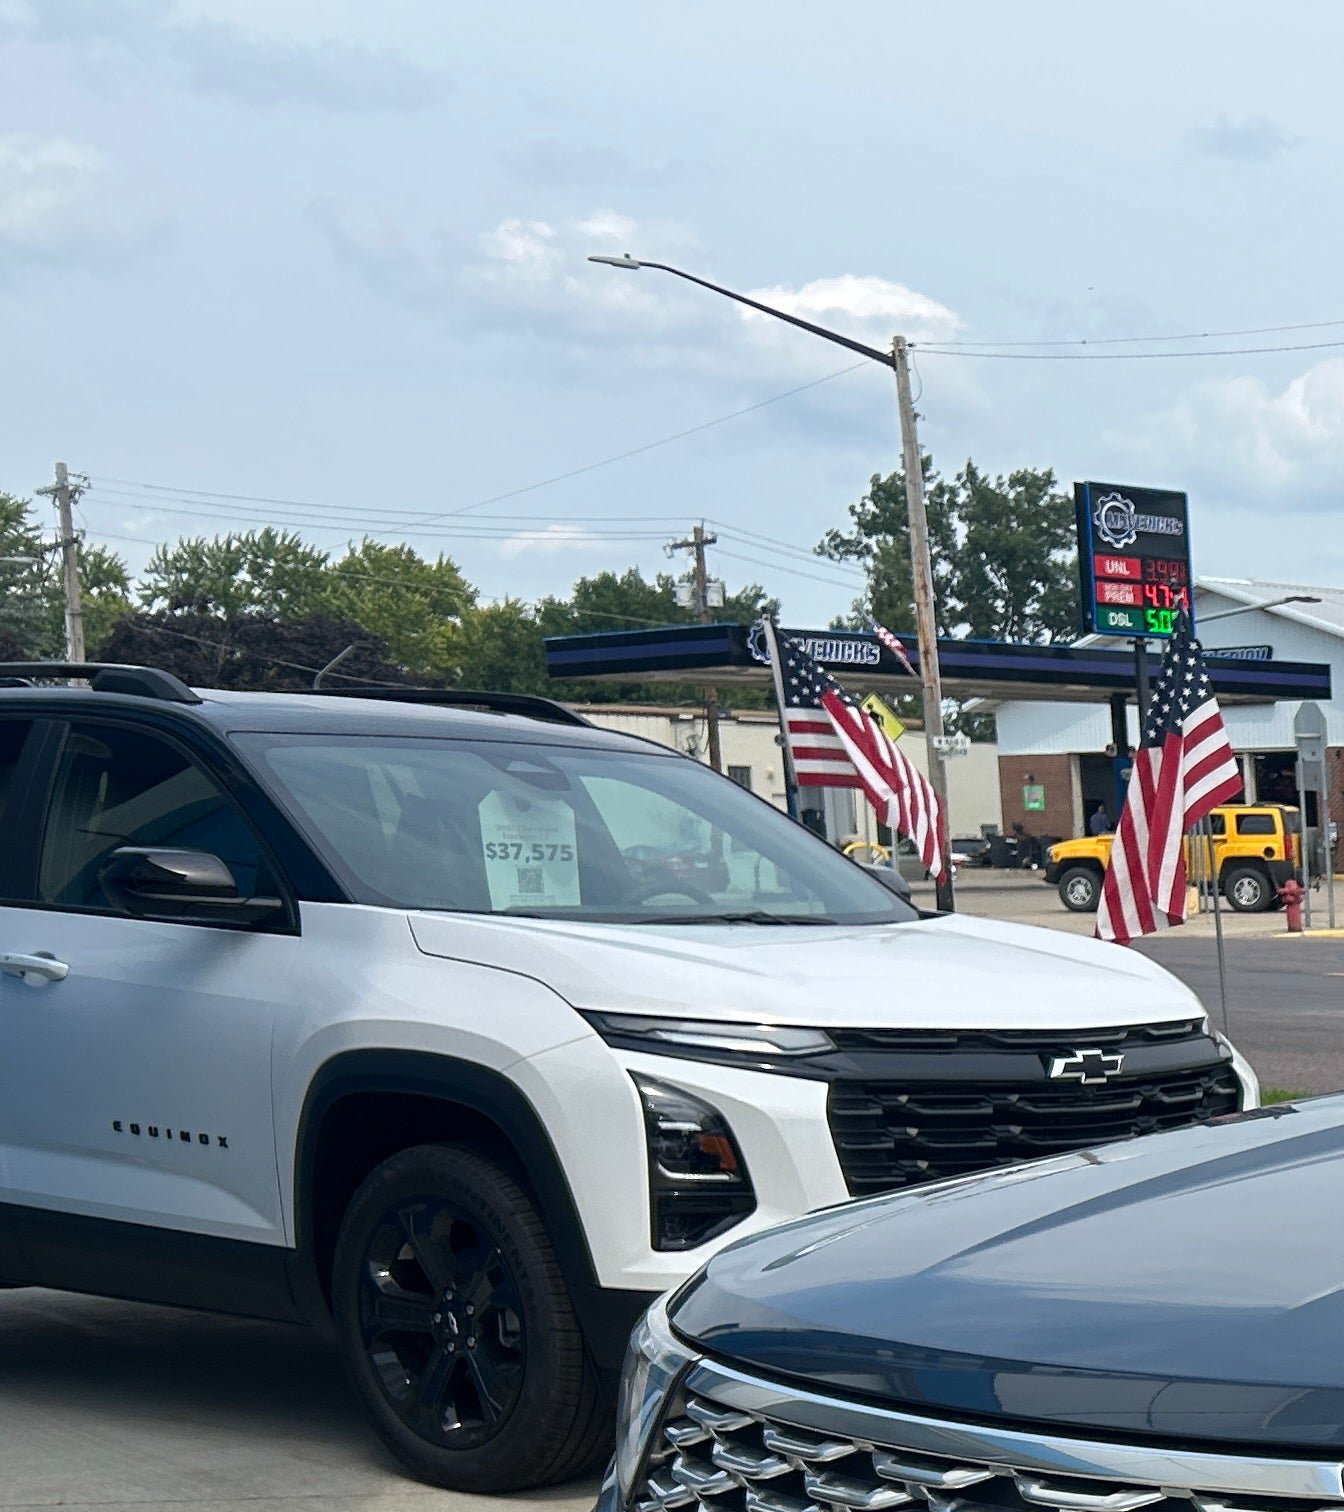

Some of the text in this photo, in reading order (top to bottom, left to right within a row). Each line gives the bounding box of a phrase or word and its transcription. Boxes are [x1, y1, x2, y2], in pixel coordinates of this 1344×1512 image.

[1104, 560, 1130, 575] UNL
[1108, 612, 1133, 627] DSL
[485, 842, 573, 864] $37,575
[112, 1120, 228, 1149] EQUINOX
